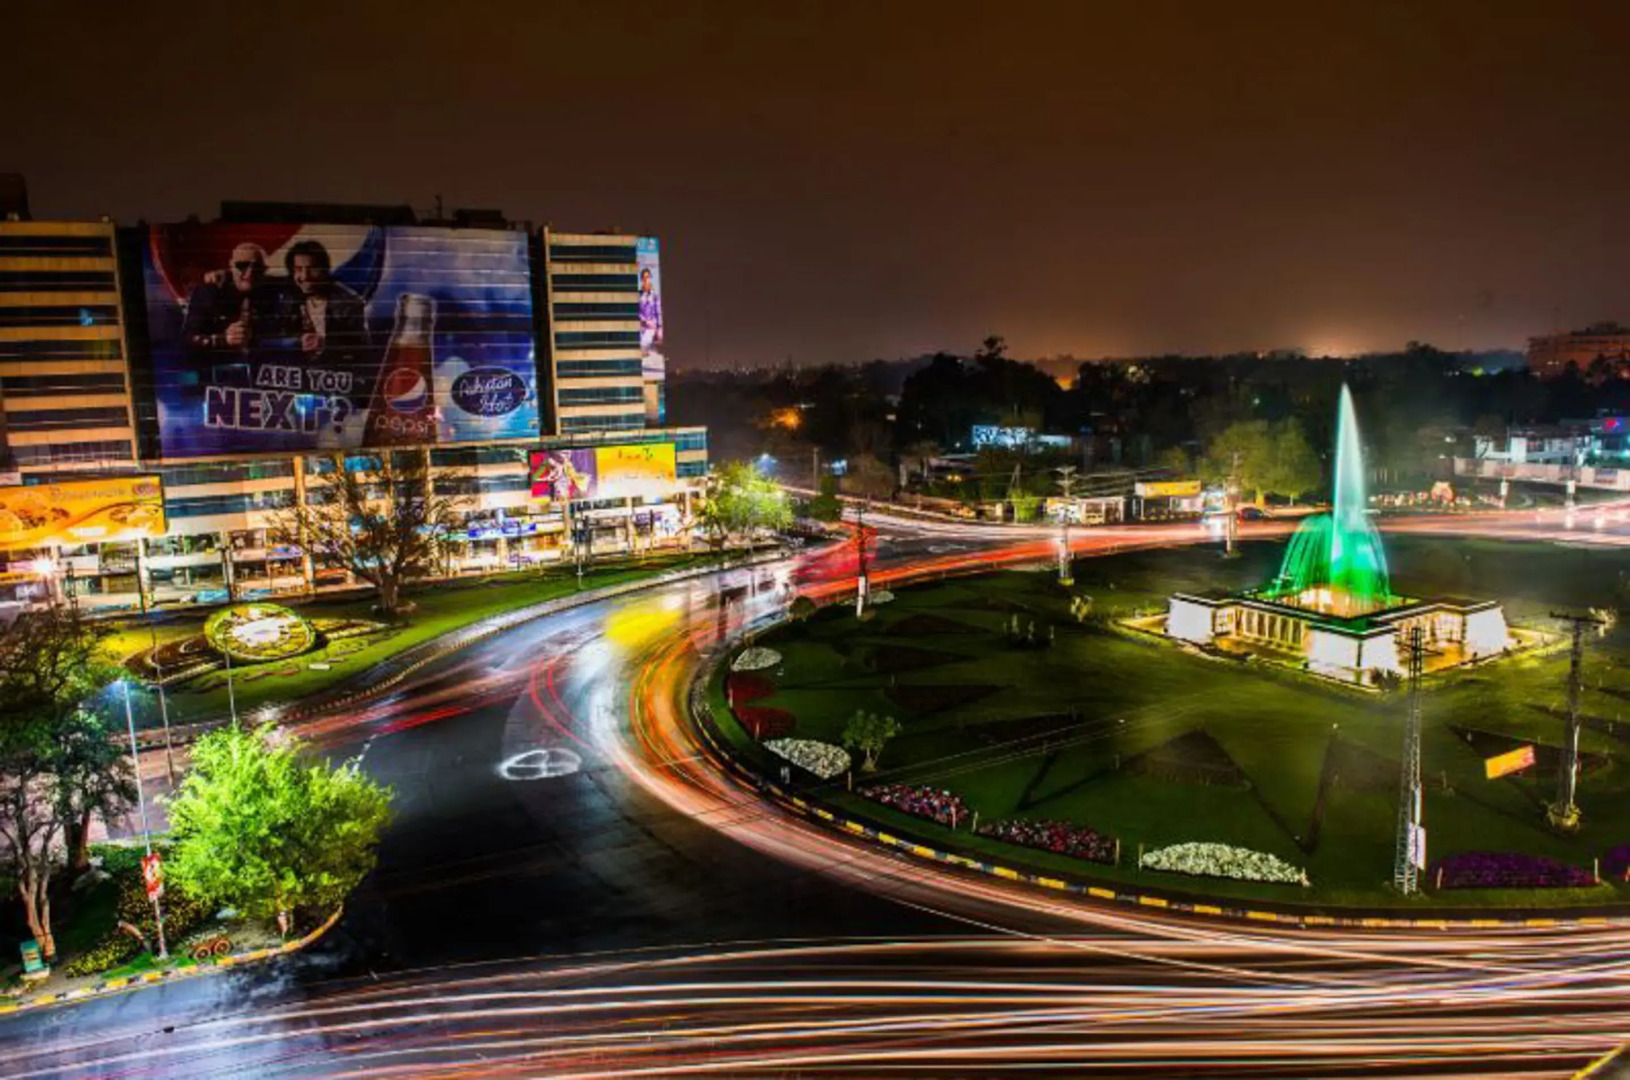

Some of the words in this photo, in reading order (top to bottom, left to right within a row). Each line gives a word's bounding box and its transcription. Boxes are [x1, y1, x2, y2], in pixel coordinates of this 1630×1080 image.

[256, 364, 301, 389] ARE
[306, 370, 352, 393] YOU
[204, 386, 351, 434] NEXT?
